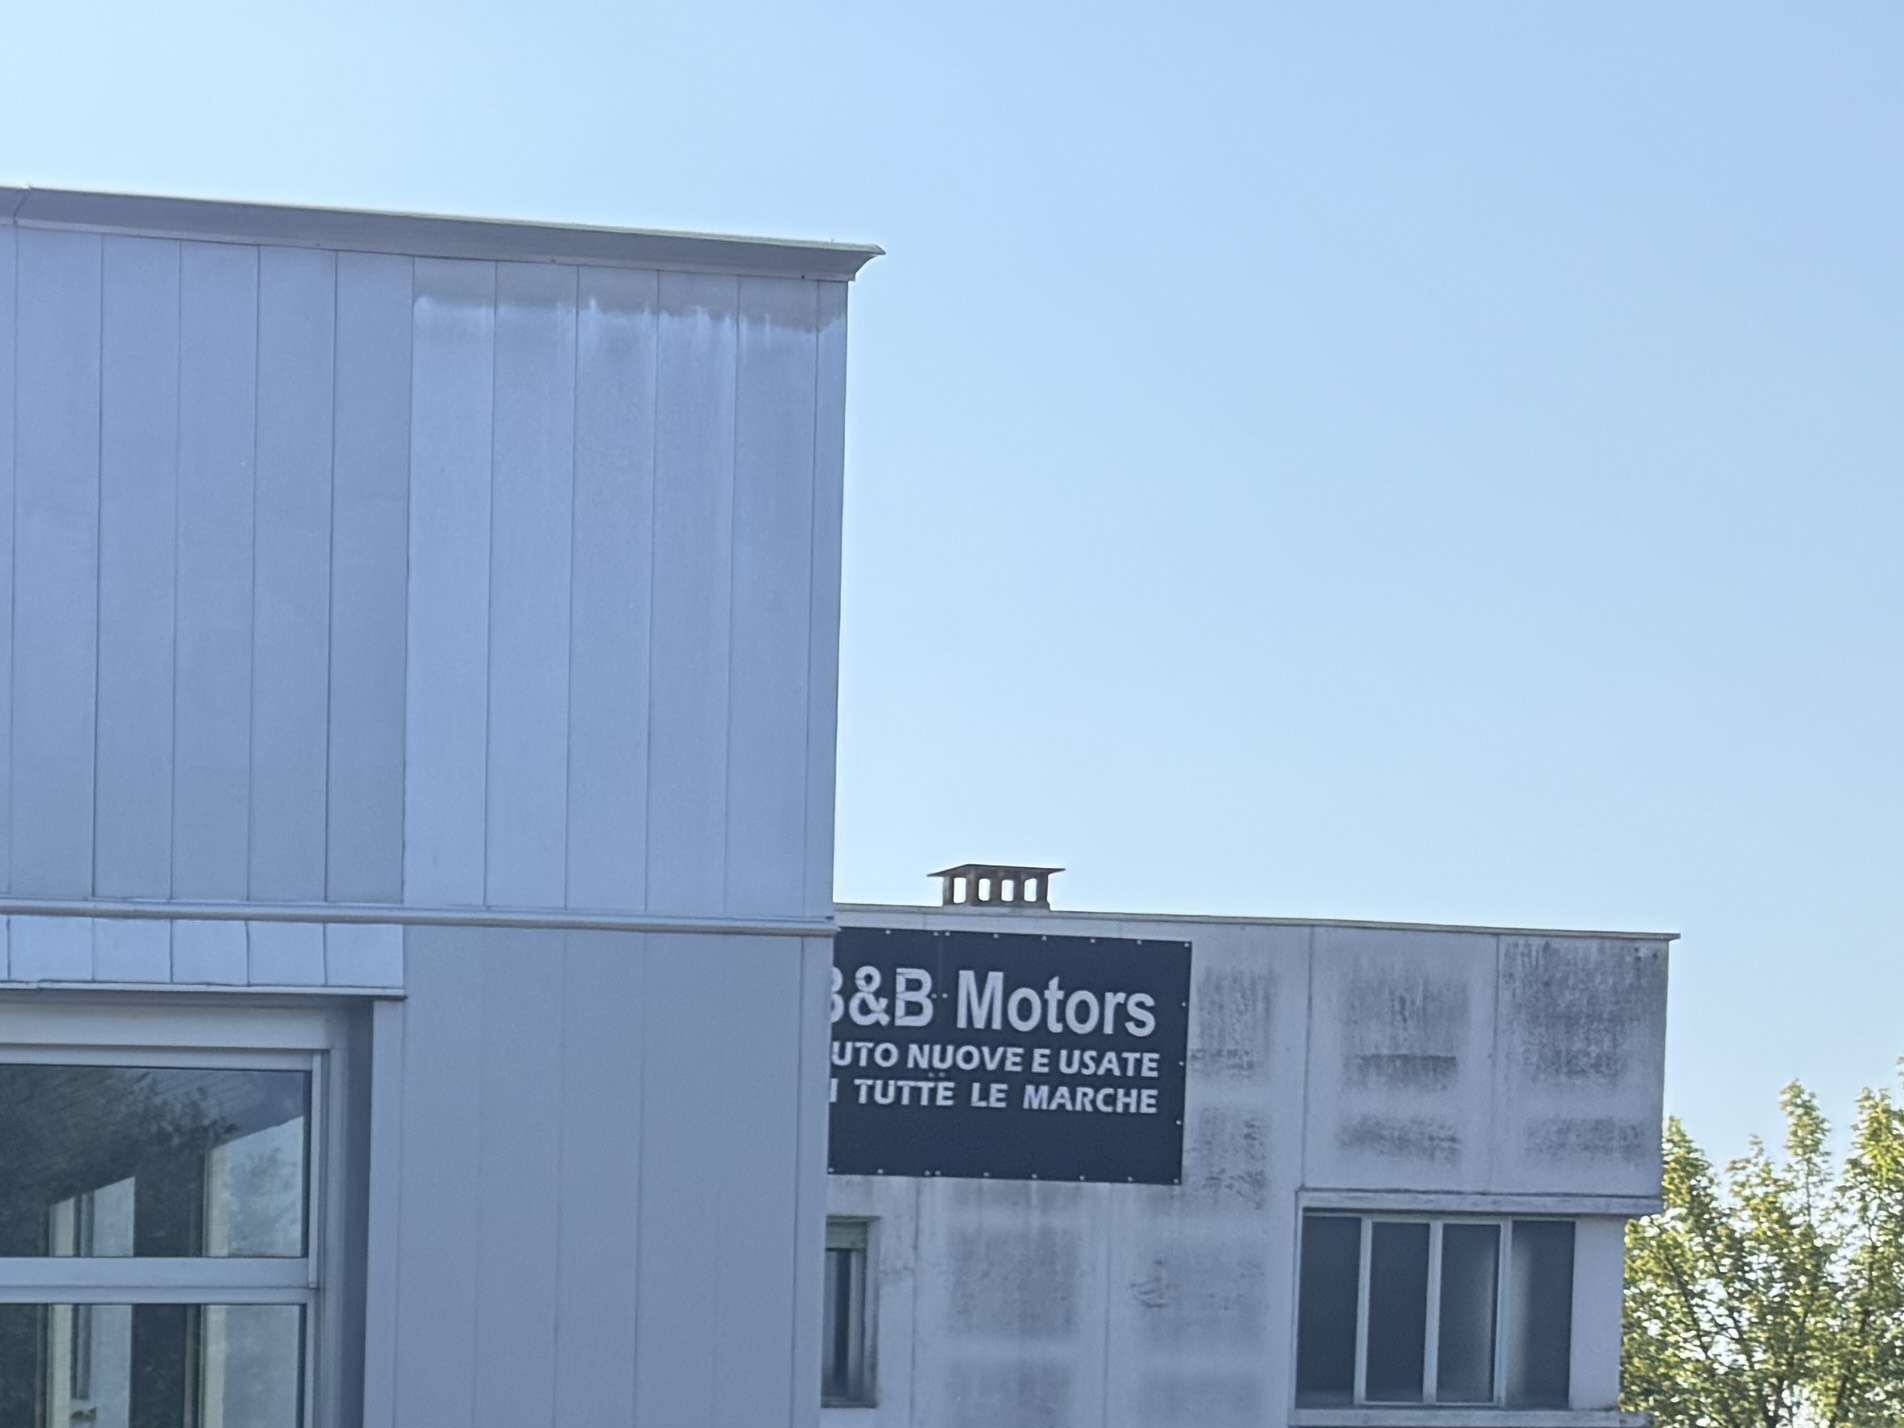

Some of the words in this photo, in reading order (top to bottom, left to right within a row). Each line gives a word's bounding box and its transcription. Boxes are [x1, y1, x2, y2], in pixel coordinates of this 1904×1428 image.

[956, 970, 1157, 1037] Motors
[831, 1041, 899, 1068] UTO
[906, 1043, 1024, 1073] NUOVE
[1031, 1048, 1050, 1074] E
[1059, 1050, 1161, 1078] USATE
[853, 1079, 955, 1107] TUTTE
[970, 1083, 1009, 1109] LE
[1022, 1084, 1159, 1115] MARCHE
